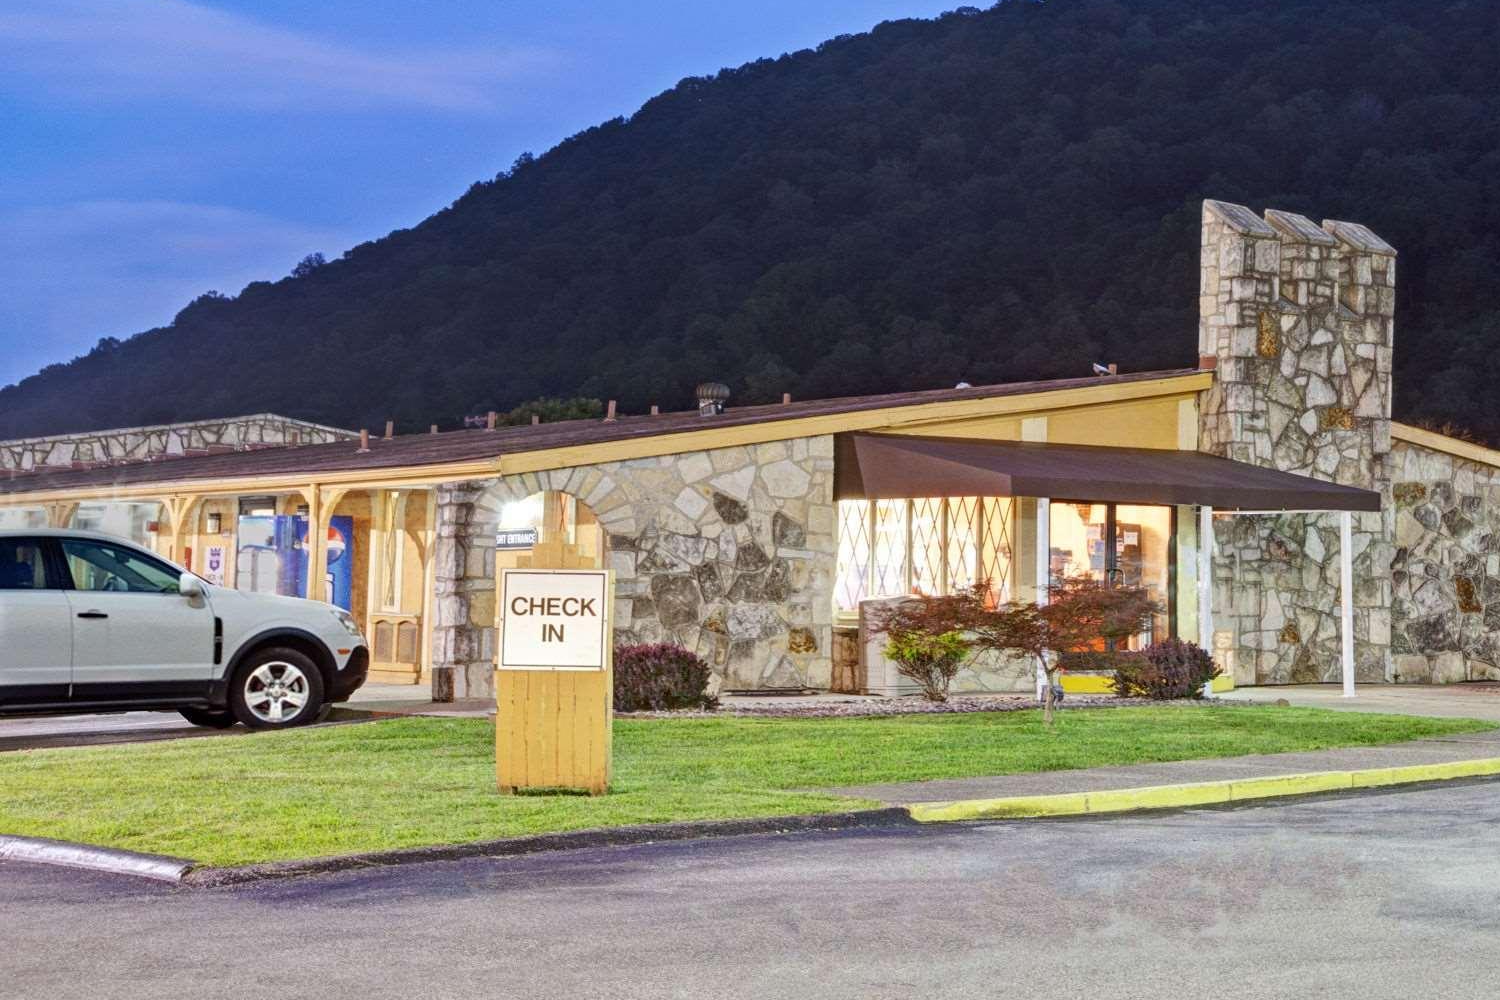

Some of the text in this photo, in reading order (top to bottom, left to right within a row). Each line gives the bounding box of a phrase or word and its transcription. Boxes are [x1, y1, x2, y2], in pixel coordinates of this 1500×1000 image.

[507, 532, 536, 545] ENTRANCE
[511, 596, 597, 617] CHECK
[541, 623, 565, 642] IN
